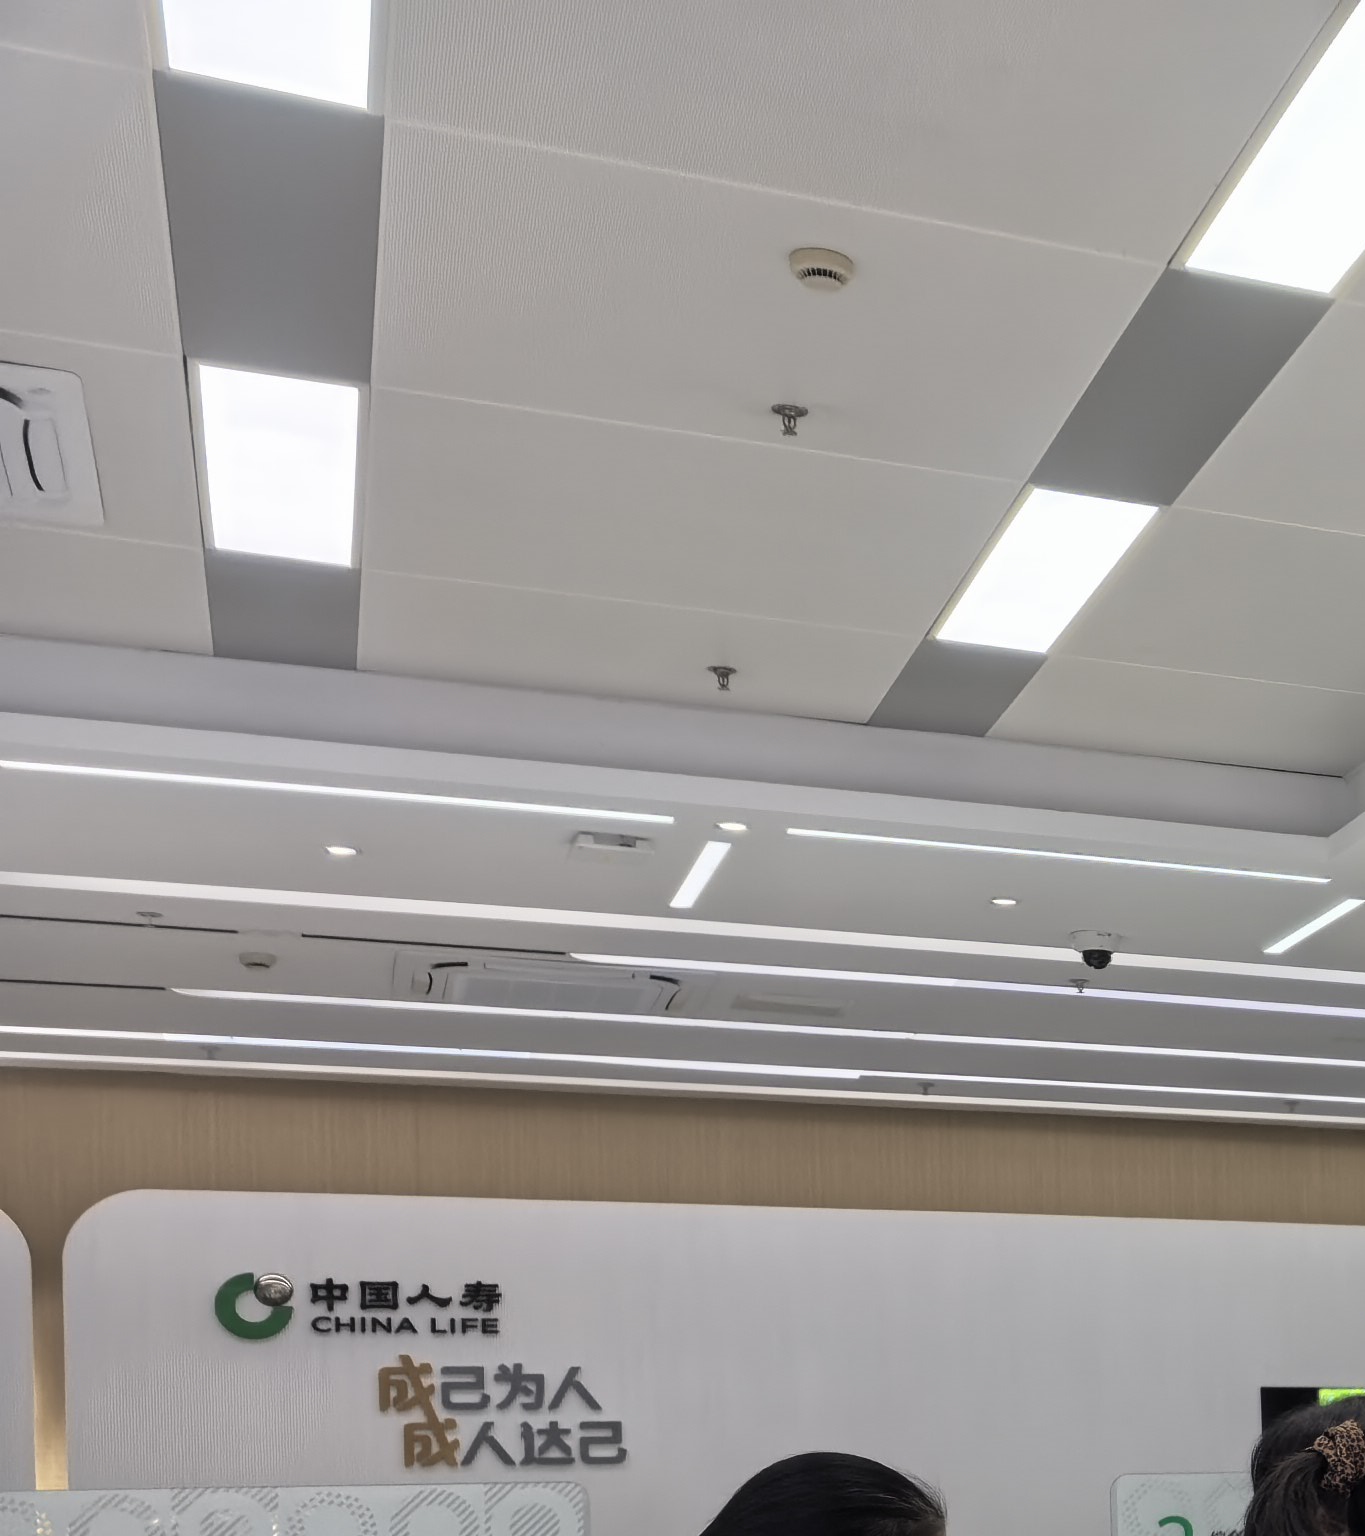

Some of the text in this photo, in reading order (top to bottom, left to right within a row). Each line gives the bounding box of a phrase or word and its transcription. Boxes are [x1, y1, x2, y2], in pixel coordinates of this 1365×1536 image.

[309, 1278, 502, 1312] 中国人寿
[311, 1316, 500, 1335] CHINA LIFE
[378, 1355, 602, 1413] 成己为人
[403, 1418, 628, 1469] 成人达己
